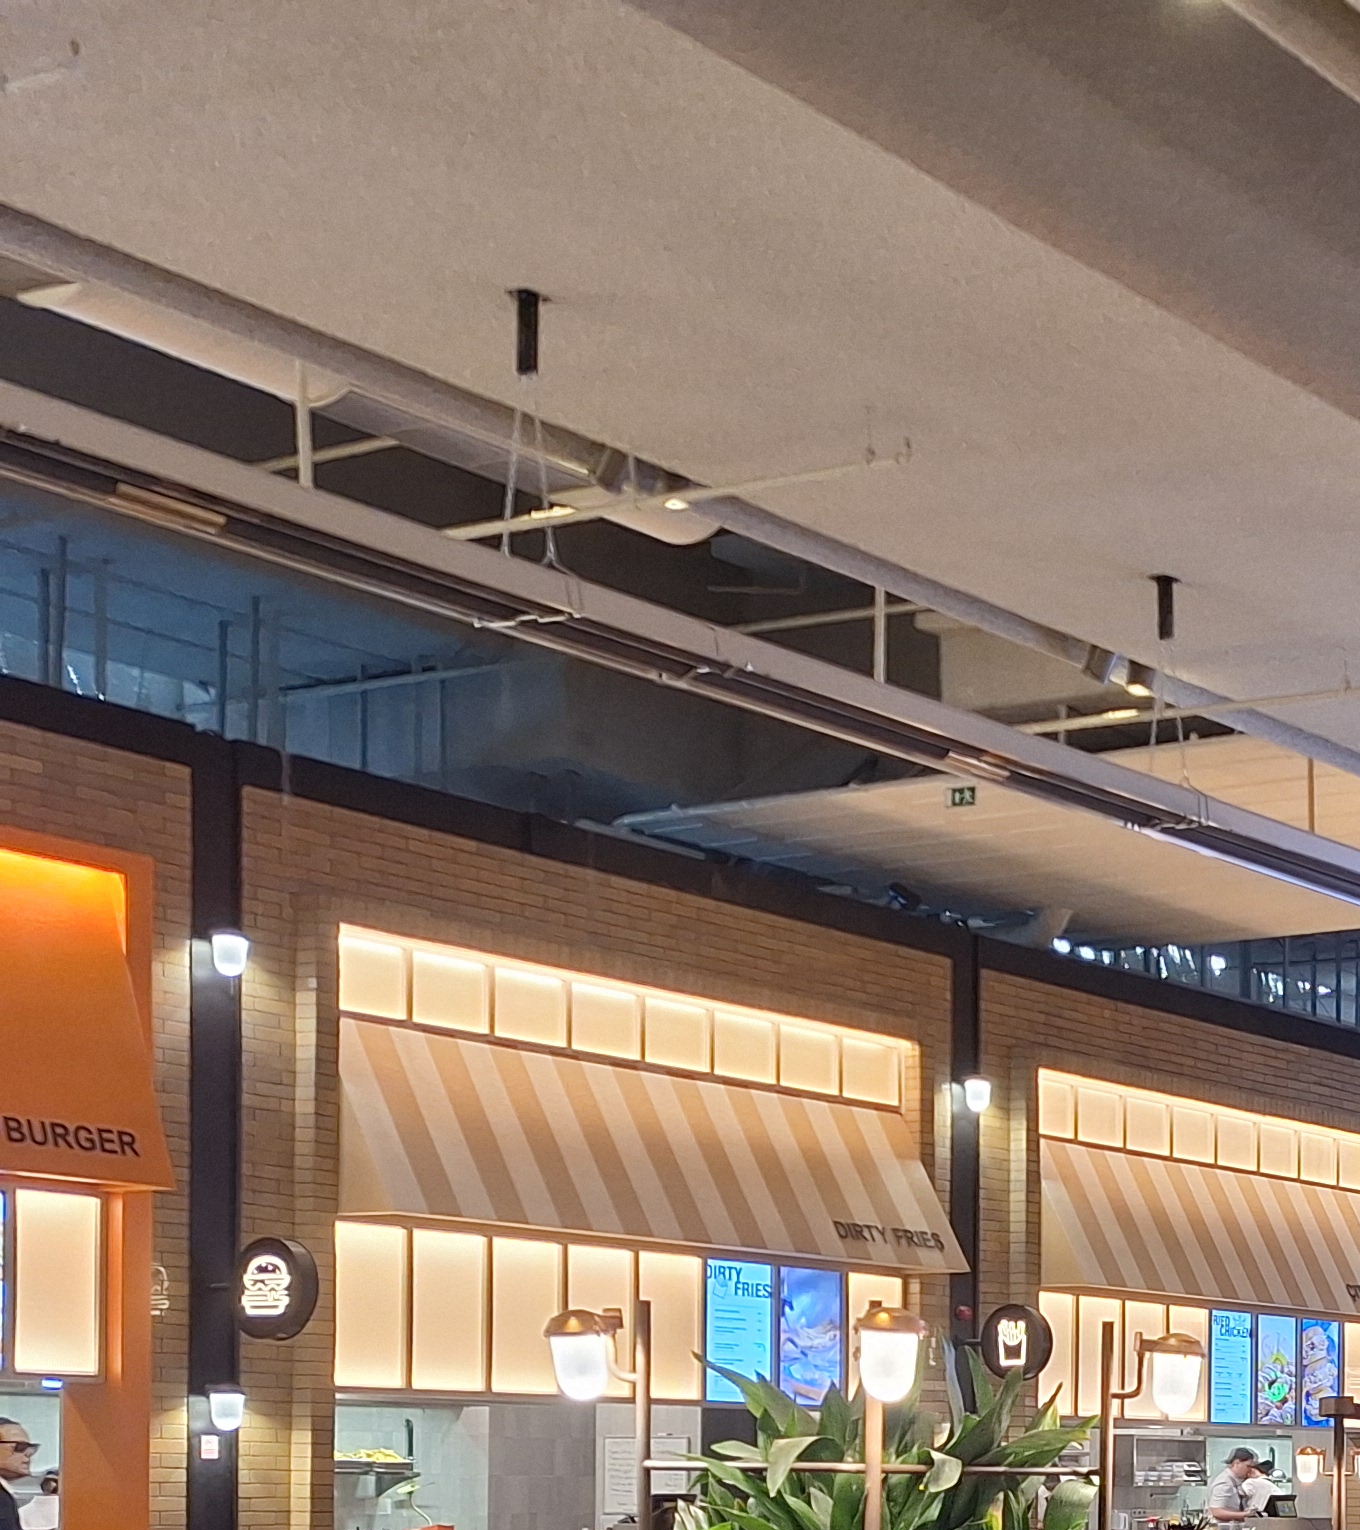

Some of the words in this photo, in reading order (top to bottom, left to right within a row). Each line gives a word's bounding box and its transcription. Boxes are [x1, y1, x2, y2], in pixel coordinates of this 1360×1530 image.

[2, 1115, 141, 1158] BURGER
[832, 1219, 888, 1244] DIRTY
[891, 1227, 946, 1252] FRIES
[707, 1264, 743, 1281] DIRTY
[734, 1281, 772, 1299] FRIES
